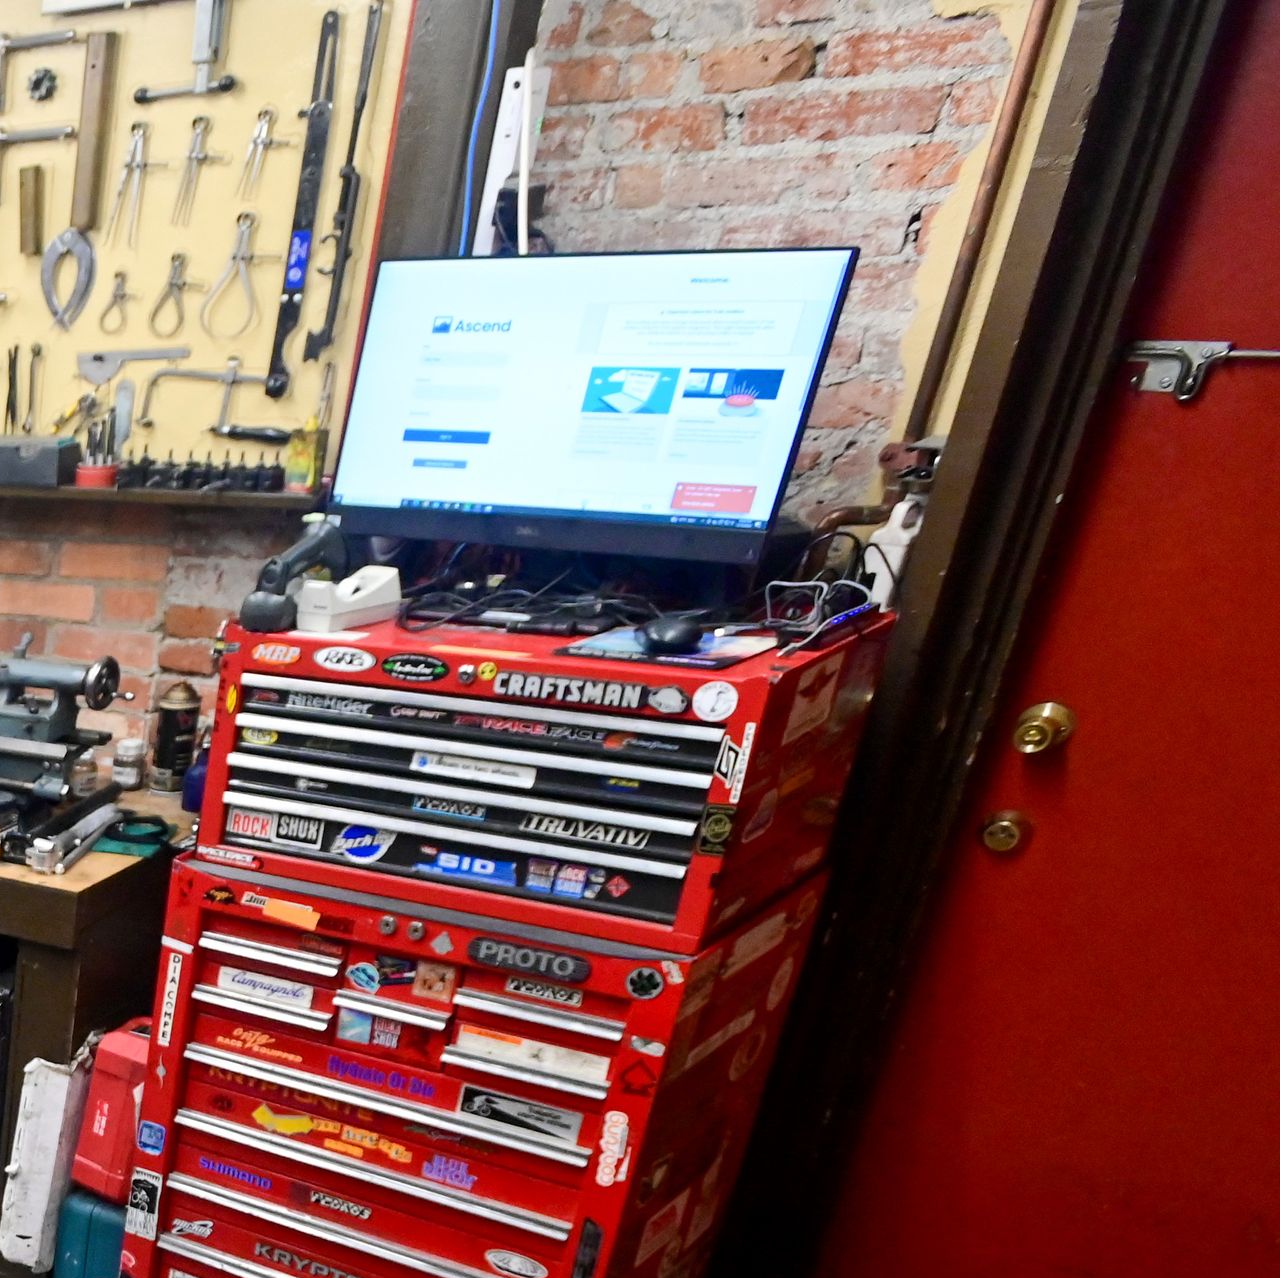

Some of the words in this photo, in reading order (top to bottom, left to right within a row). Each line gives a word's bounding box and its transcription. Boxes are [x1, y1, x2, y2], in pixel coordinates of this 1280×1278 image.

[454, 319, 513, 334] Ascend
[253, 643, 302, 664] MRP
[493, 672, 644, 708] CRAFTSMAN
[231, 812, 270, 837] ROCK
[278, 814, 321, 841] SHOX
[527, 813, 648, 848] TRUVATIV
[438, 852, 497, 875] SID
[168, 954, 182, 986] DIA
[478, 941, 577, 978] PROTO
[230, 969, 307, 1000] Campagnolo
[160, 989, 176, 1041] COMPE
[327, 1054, 387, 1086] Hydrate
[388, 1072, 407, 1091] Or
[198, 1155, 274, 1191] SHIMANO
[310, 1190, 373, 1220] PEDROS
